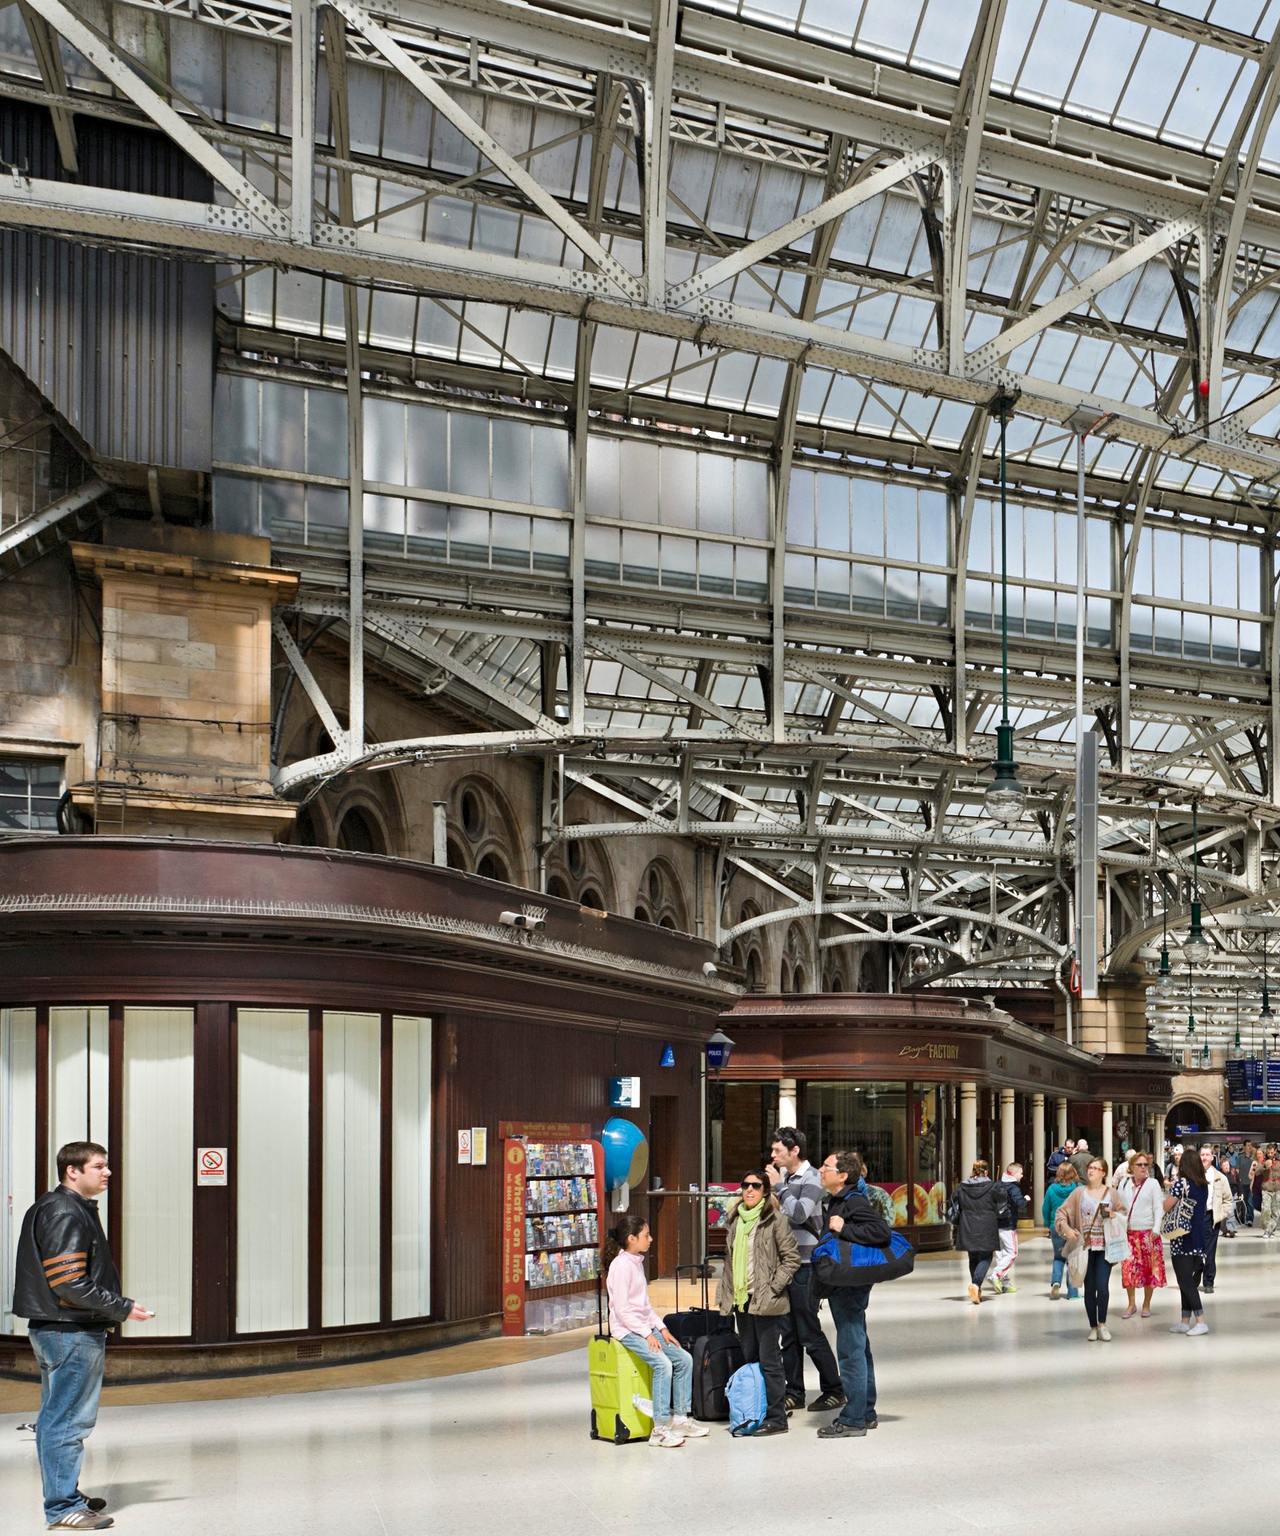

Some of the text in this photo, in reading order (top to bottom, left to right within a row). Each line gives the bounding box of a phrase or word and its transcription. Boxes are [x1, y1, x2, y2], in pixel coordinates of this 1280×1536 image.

[708, 1049, 722, 1057] POLICE
[929, 1043, 960, 1059] FACTORY
[512, 1172, 525, 1284] what's on info
